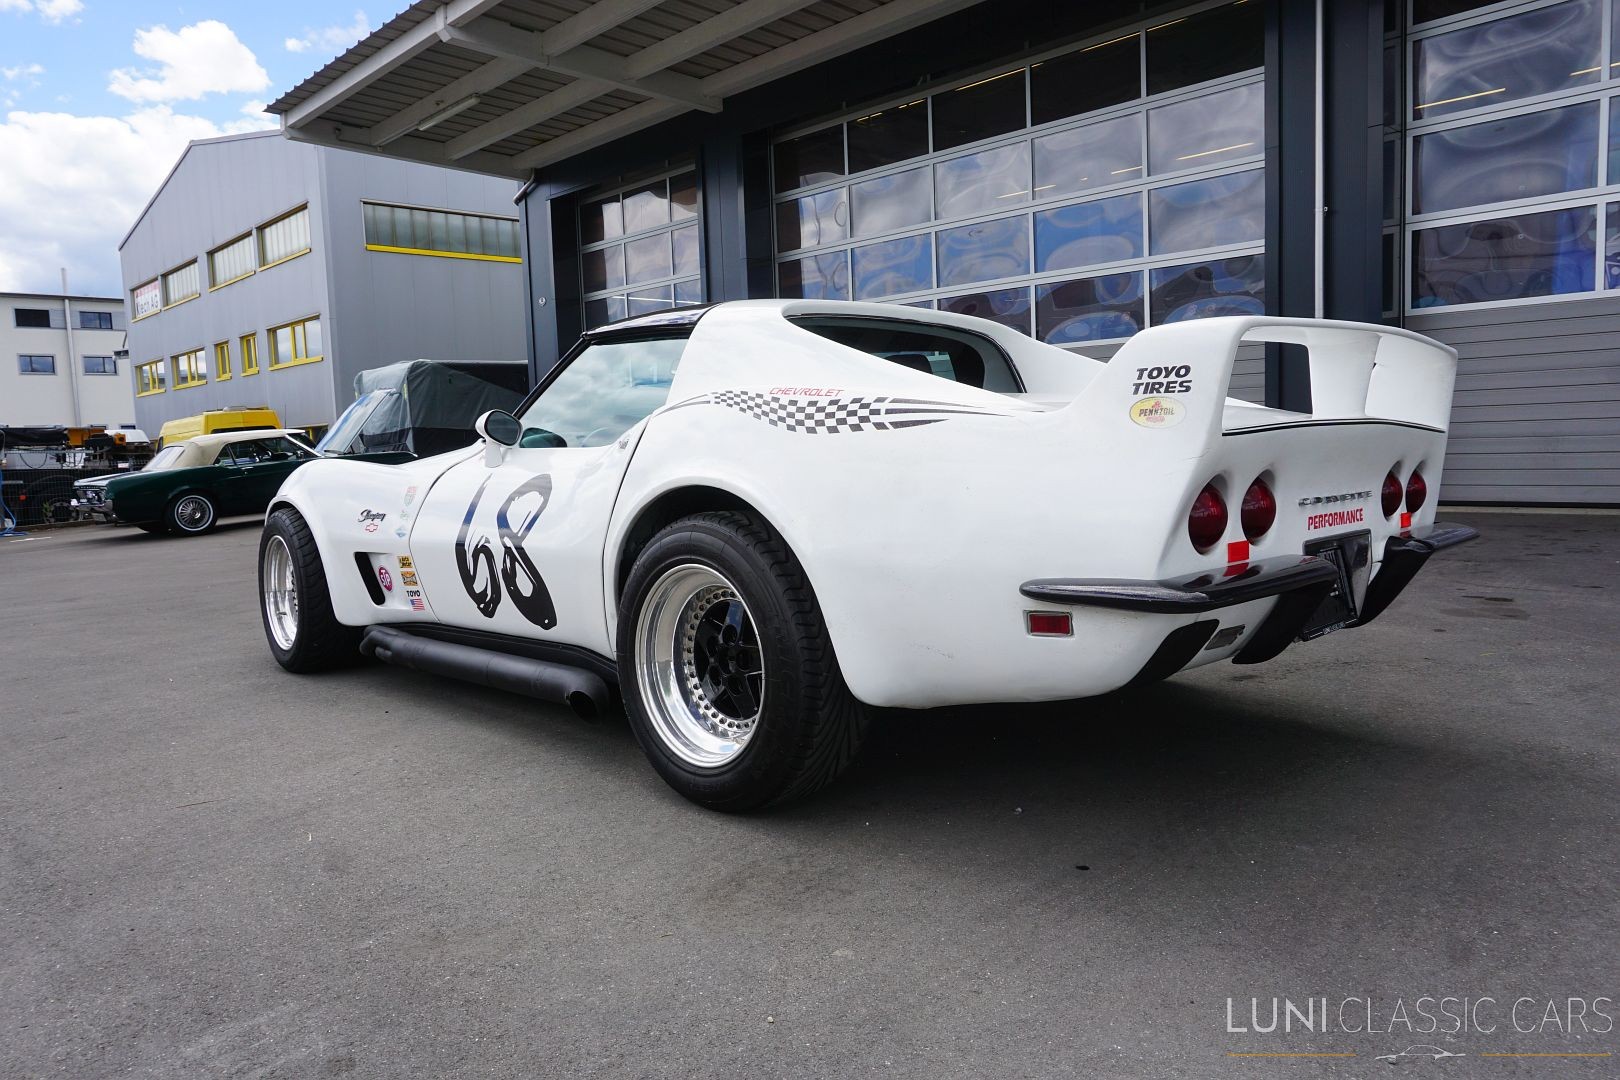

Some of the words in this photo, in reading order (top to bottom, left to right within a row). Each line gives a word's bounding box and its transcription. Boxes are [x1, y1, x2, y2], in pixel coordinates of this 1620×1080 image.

[1136, 364, 1192, 380] TOYO
[769, 387, 845, 397] CHEVROLET
[1132, 379, 1193, 395] TIRES
[1307, 508, 1364, 531] PERFORMANCE
[455, 473, 557, 630] 68
[379, 569, 391, 587] STP
[406, 590, 421, 598] TOYO
